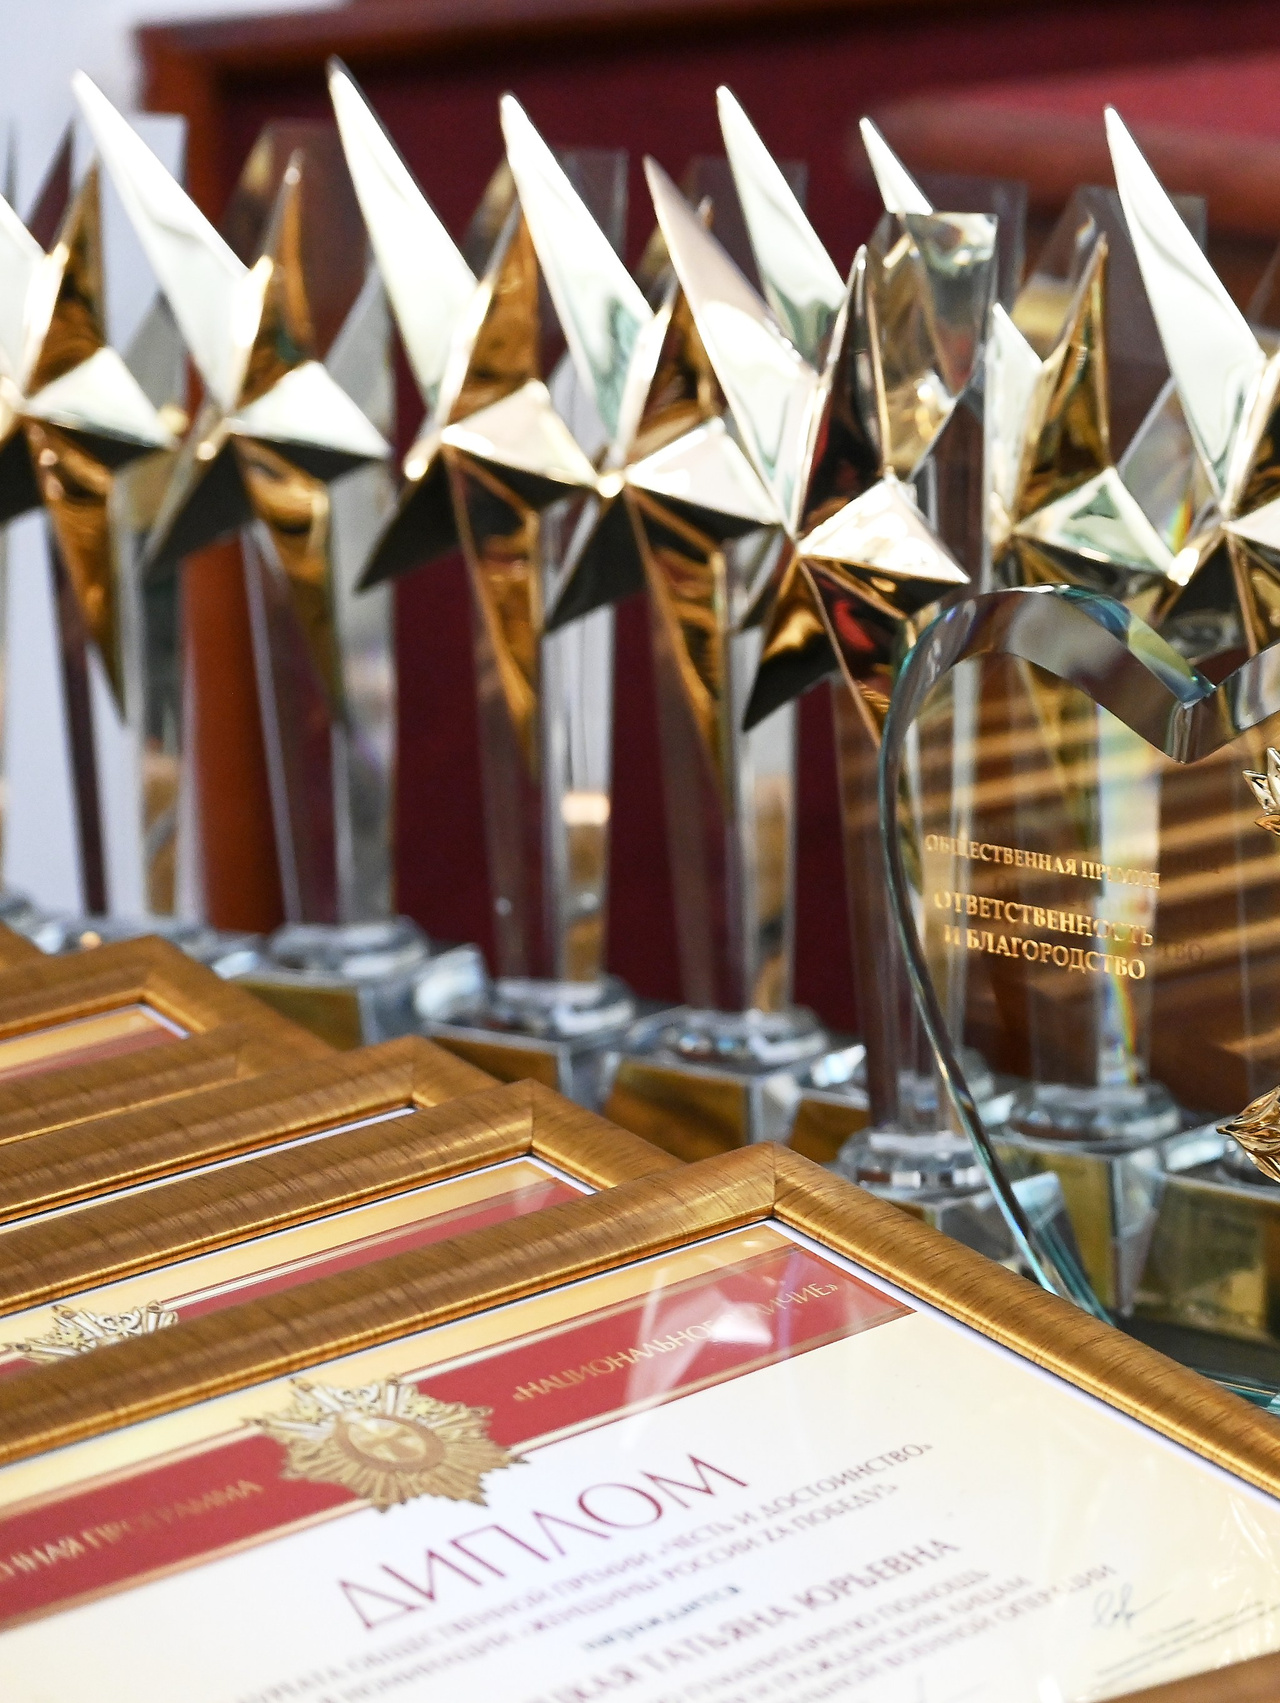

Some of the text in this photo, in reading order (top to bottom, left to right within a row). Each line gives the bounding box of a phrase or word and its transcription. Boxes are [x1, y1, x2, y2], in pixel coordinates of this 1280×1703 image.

[924, 833, 1078, 877] ОБЩЕСТВЕННАЯ
[933, 890, 1154, 946] ОТВЕТСТВЕННОСТЬ
[944, 925, 961, 945] И
[966, 928, 1146, 980] БЛАГОРОДСТВО
[760, 1442, 933, 1520] ДОСТОИНСТВО»
[339, 1454, 748, 1630] ДИПЛОМ
[641, 1602, 800, 1674] ТАТЬЯНА
[792, 1536, 961, 1612] ЮРЬЕВНА
